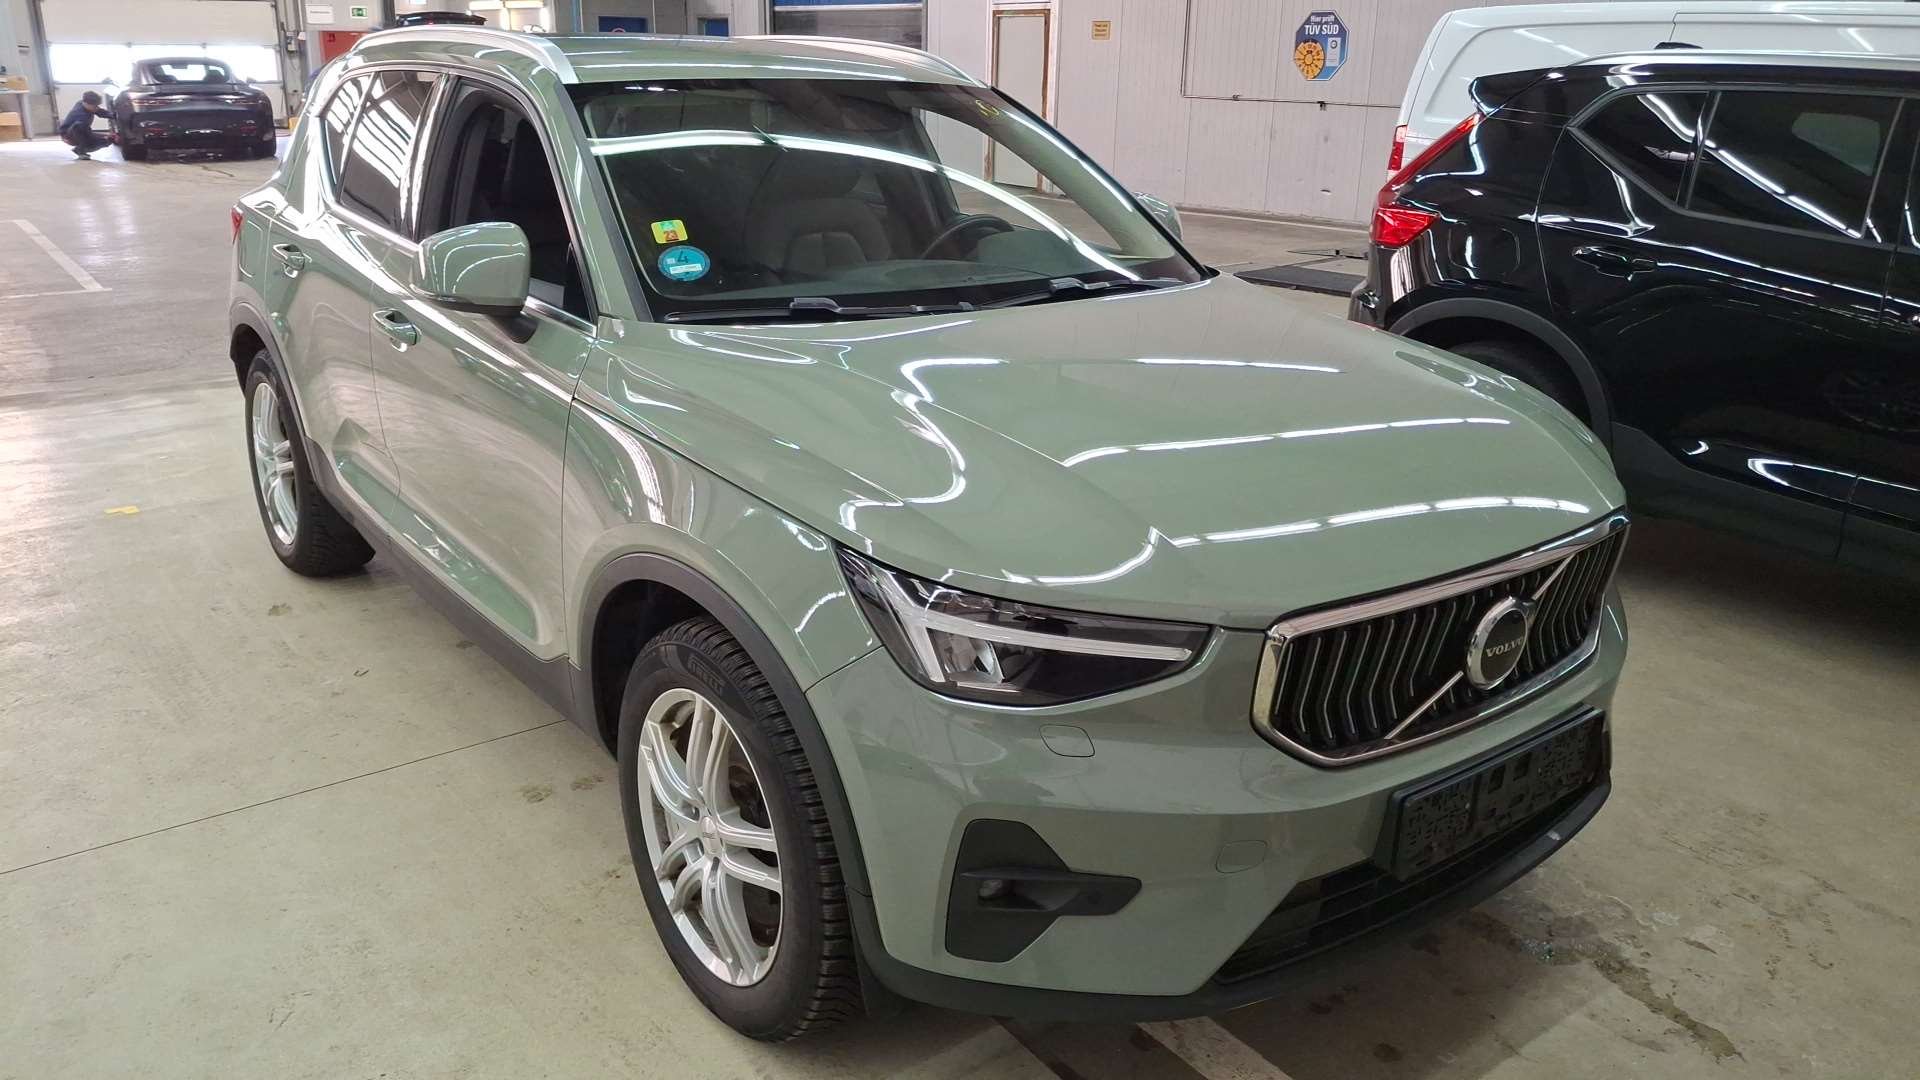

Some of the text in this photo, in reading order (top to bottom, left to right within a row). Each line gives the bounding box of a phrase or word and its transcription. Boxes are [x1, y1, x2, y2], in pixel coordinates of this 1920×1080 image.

[1304, 23, 1340, 35] TÜV SÜD
[677, 250, 689, 264] 4
